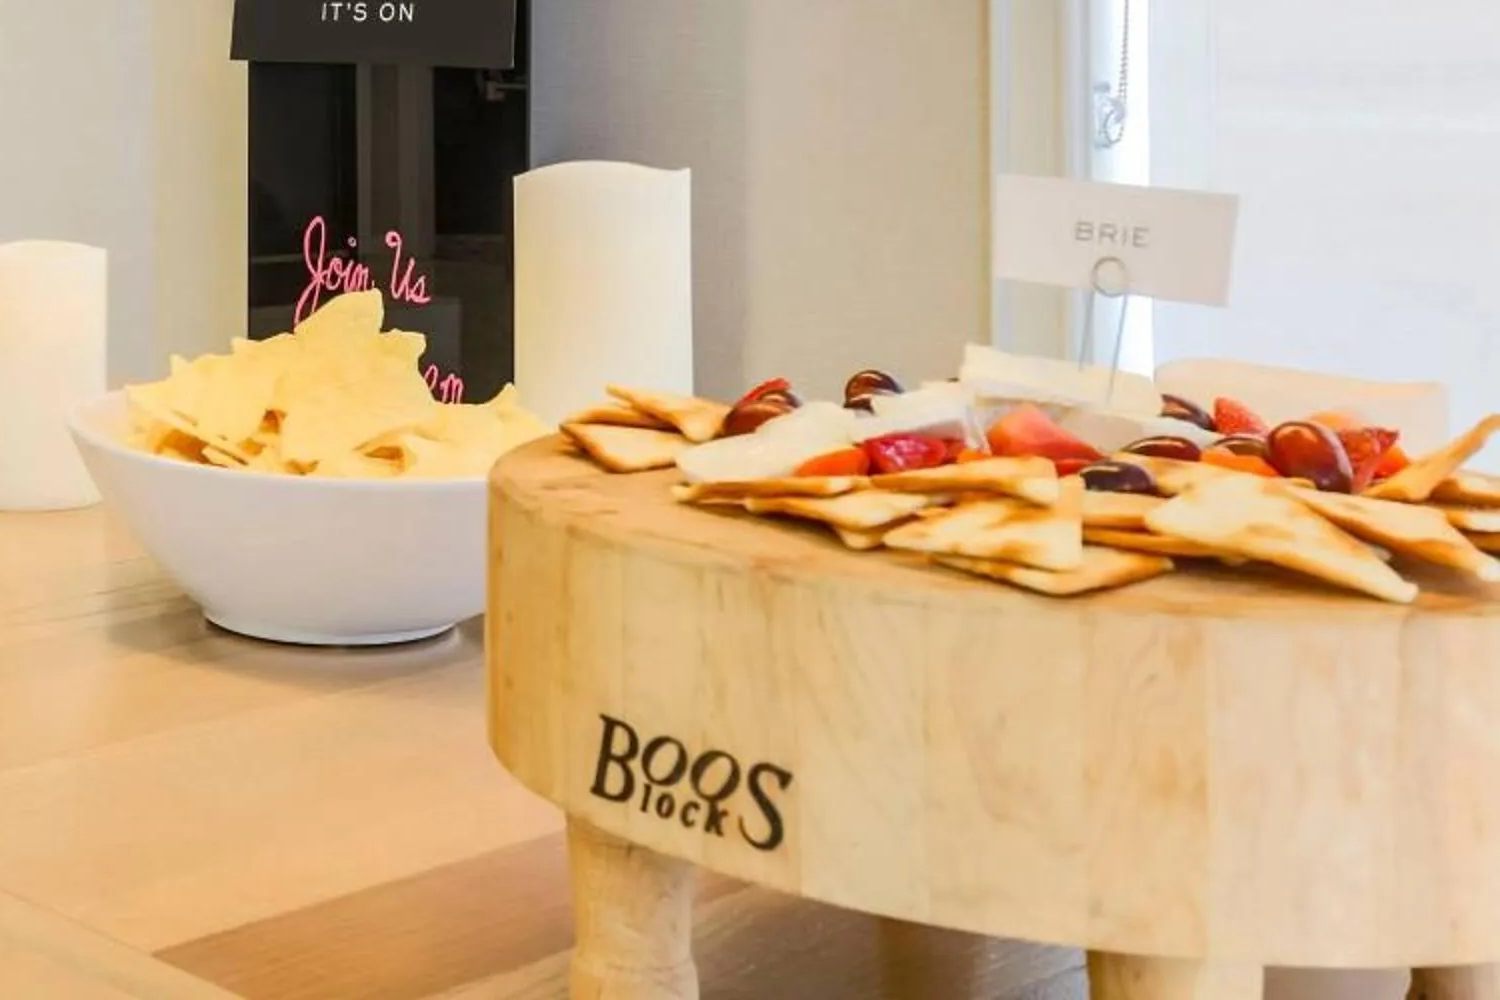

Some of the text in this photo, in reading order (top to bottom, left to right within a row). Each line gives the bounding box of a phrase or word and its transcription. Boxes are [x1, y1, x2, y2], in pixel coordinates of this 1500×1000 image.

[321, 2, 414, 22] IT'S ON
[1074, 220, 1150, 249] BRIE
[294, 215, 431, 324] Join Us
[589, 712, 794, 852] BOOS
